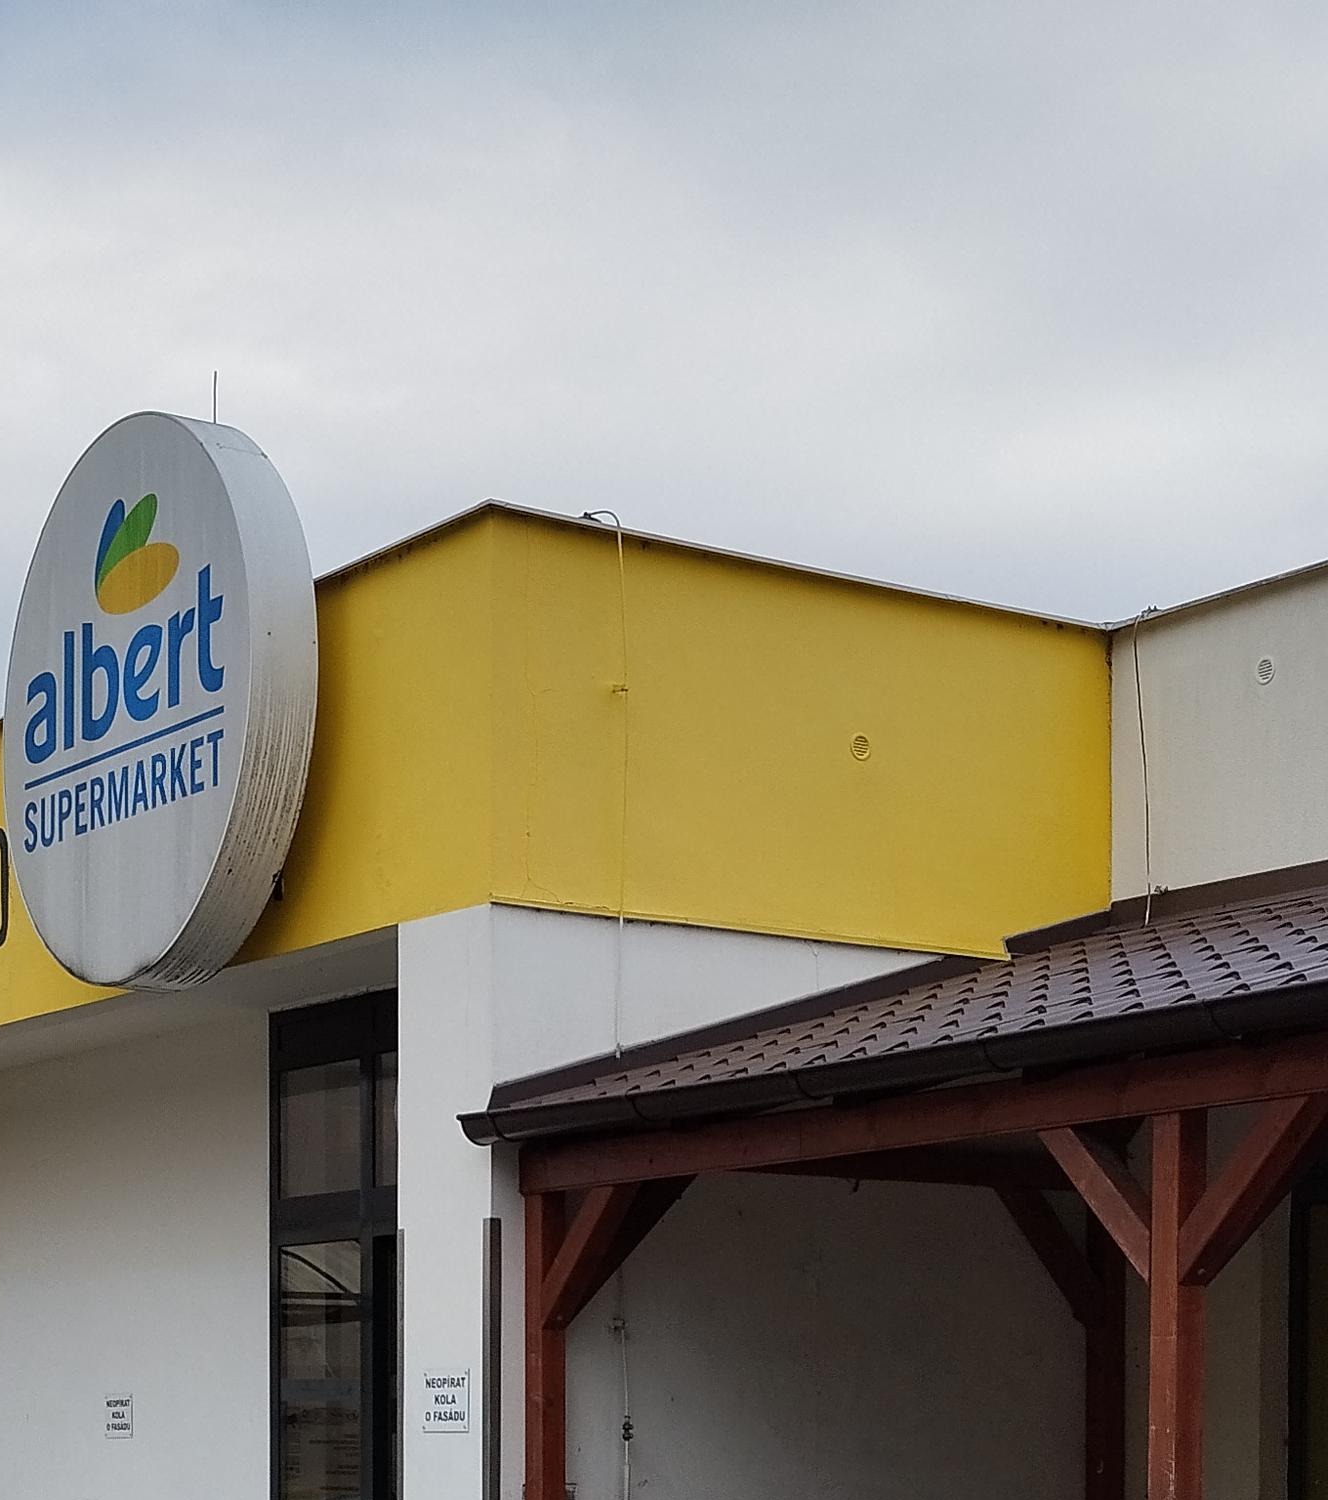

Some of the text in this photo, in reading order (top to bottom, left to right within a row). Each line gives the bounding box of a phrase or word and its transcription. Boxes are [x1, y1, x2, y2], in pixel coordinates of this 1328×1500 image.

[25, 563, 225, 765] albert
[23, 729, 224, 853] SUPERMARKET
[425, 1375, 466, 1389] NEOPÍRAT
[434, 1394, 457, 1405] KOLA
[425, 1408, 466, 1422] O FASÁDU
